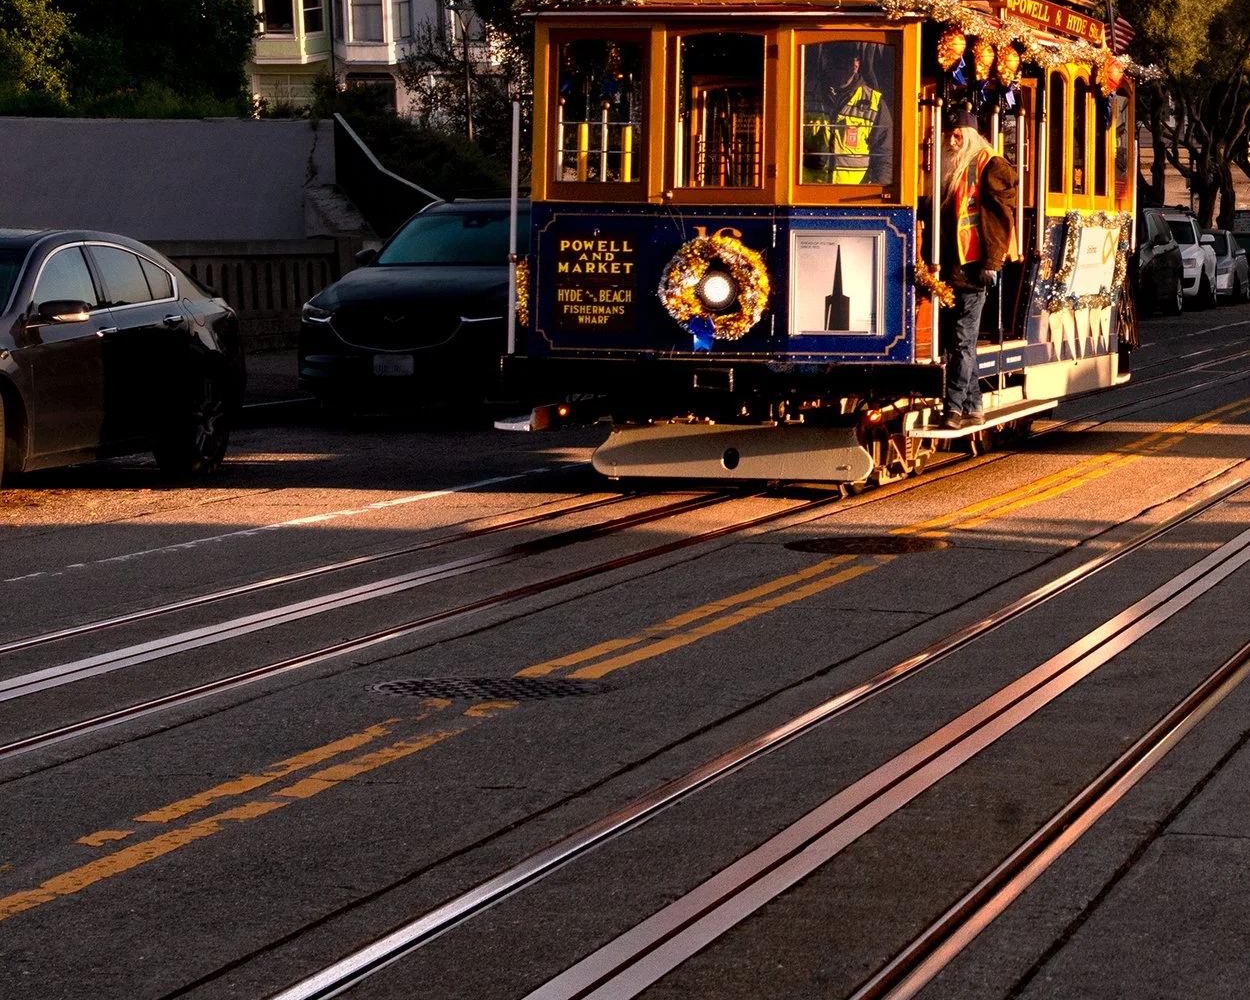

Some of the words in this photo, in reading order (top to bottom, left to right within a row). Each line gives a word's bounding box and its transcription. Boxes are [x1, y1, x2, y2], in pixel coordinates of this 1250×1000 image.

[1055, 10, 1062, 26] &
[1066, 13, 1088, 34] HYDE
[560, 240, 633, 252] POWELL
[578, 252, 615, 261] AND
[558, 262, 633, 273] MARKET
[557, 289, 583, 302] HYDE
[599, 289, 632, 302] BEACH
[563, 305, 625, 315] FISHERMANS
[578, 315, 610, 324] WHARF
